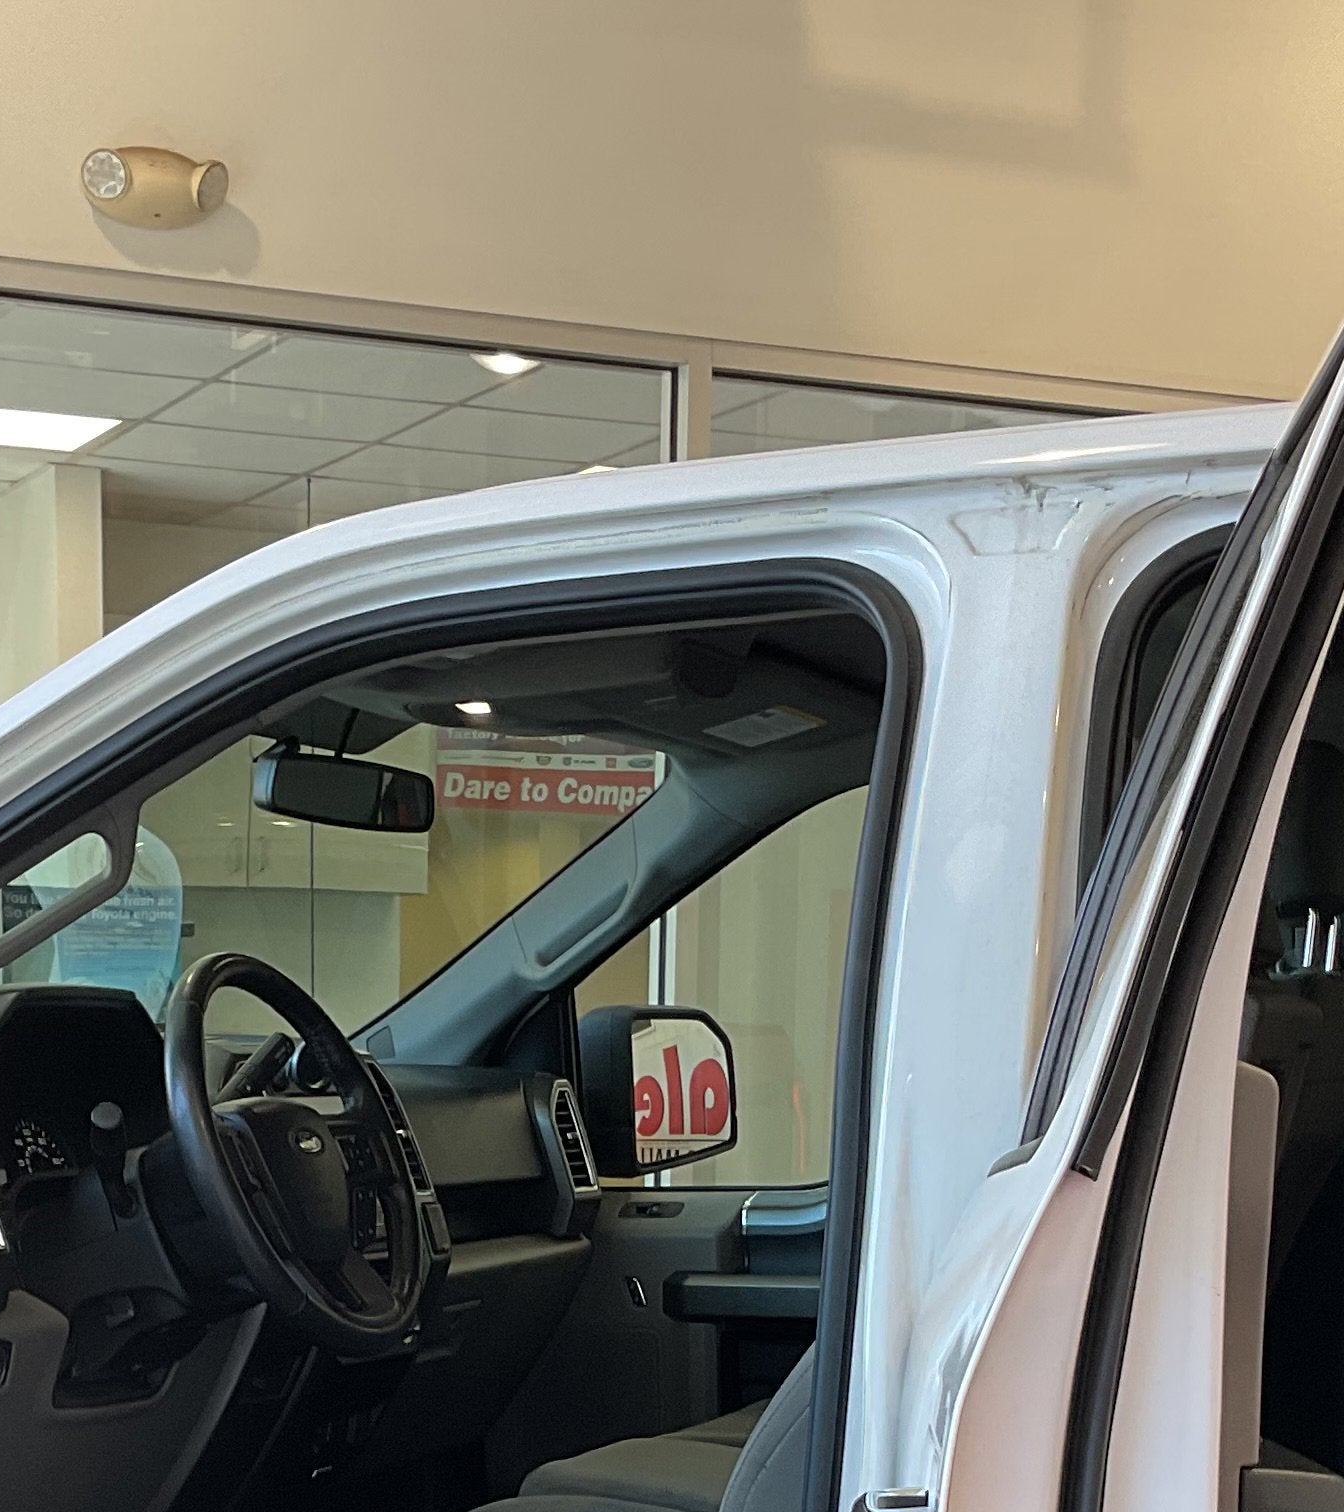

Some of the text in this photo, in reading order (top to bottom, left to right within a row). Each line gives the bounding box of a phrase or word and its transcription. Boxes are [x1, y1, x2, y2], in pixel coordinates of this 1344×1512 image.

[444, 772, 510, 800] Dare
[521, 777, 548, 802] to
[91, 909, 130, 921] Toyota
